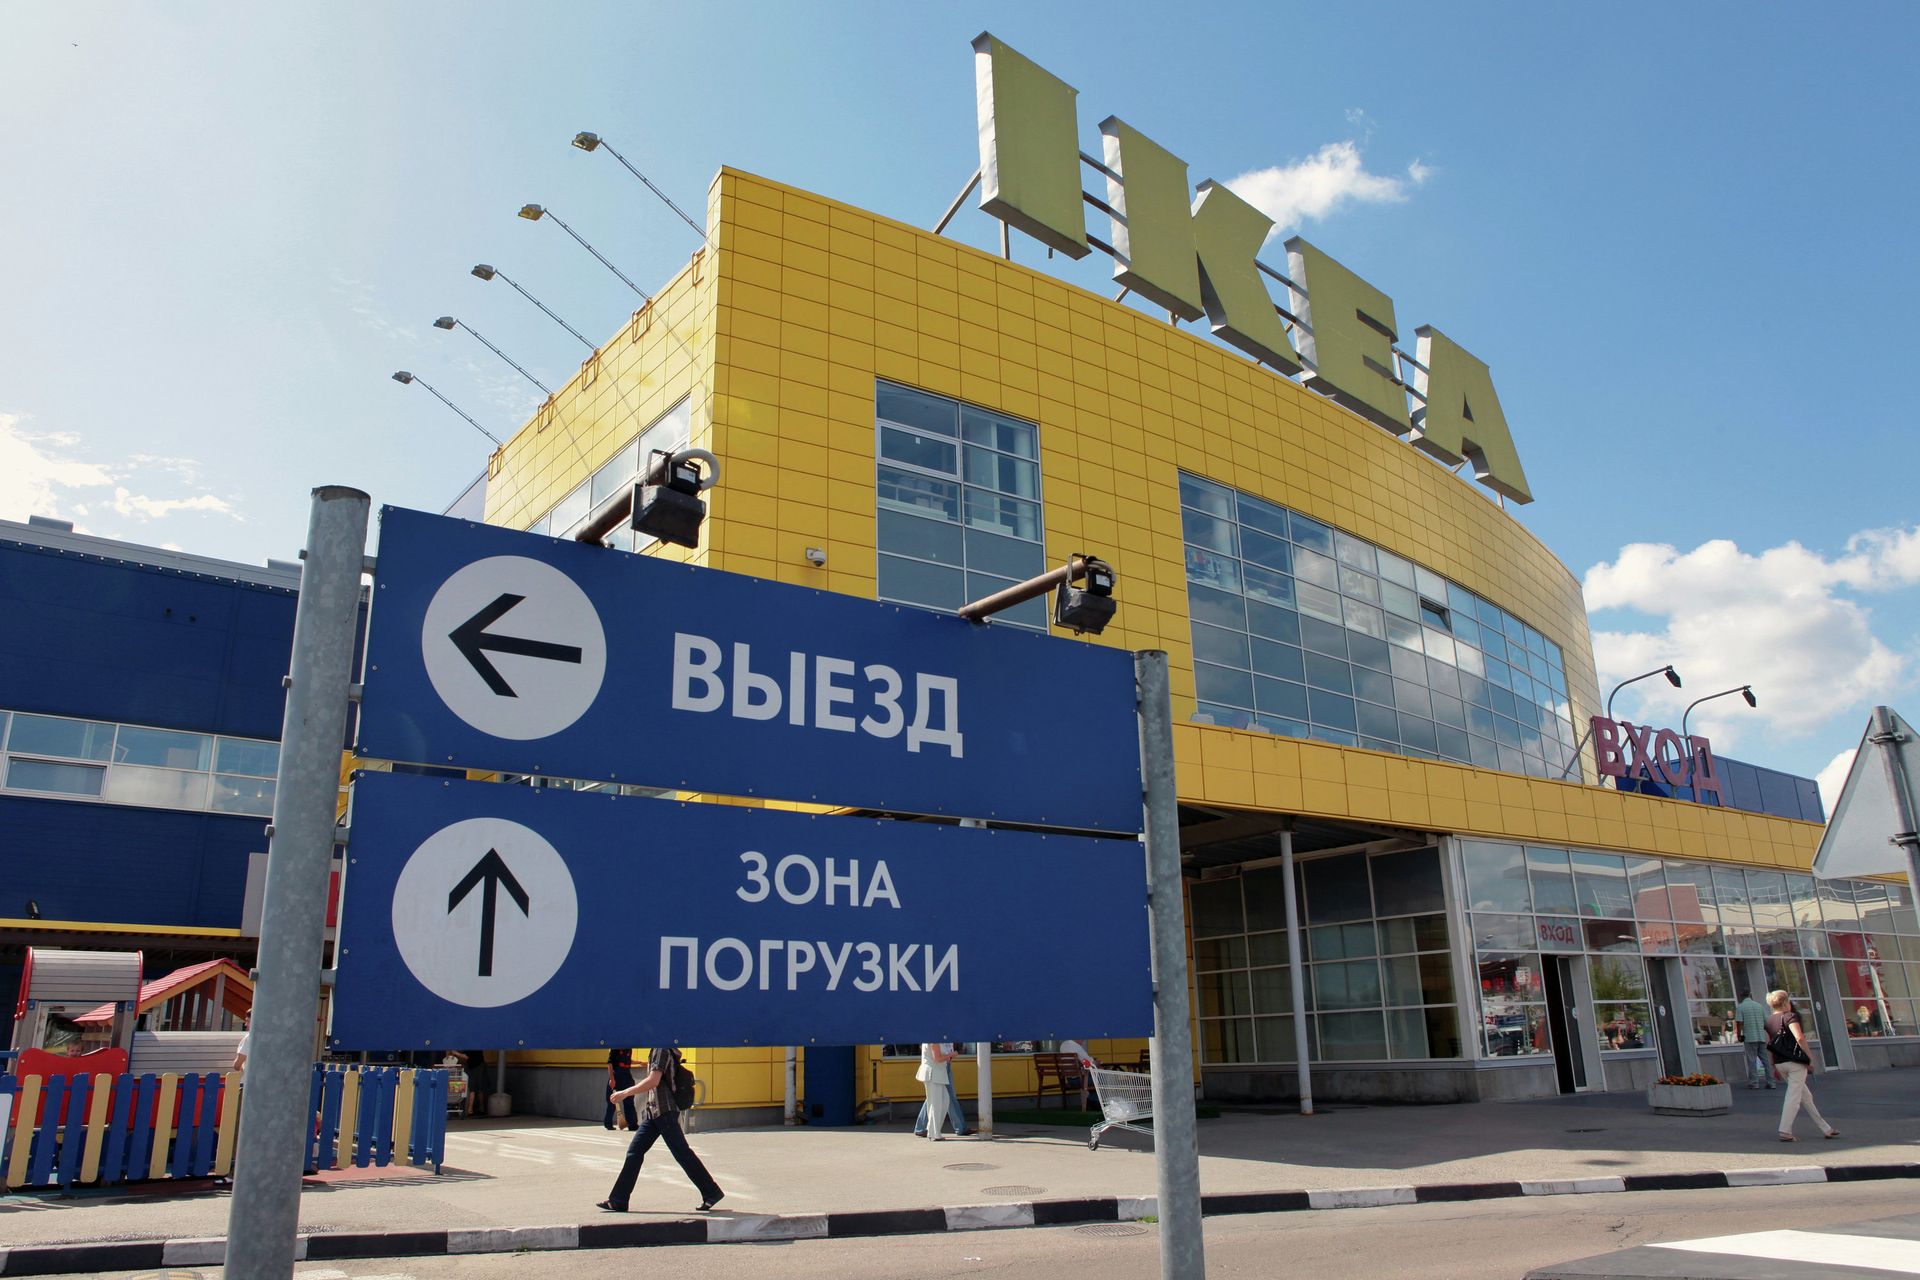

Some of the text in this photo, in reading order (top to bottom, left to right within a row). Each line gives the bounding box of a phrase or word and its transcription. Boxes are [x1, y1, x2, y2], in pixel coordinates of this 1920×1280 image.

[971, 31, 1533, 505] IKEA
[672, 632, 963, 759] ВЫЕЗД
[1590, 716, 1725, 807] ВХОД
[736, 851, 901, 909] ЗОНА
[659, 936, 958, 993] ПОГРУЗКИ
[1540, 924, 1575, 944] ВХОД
